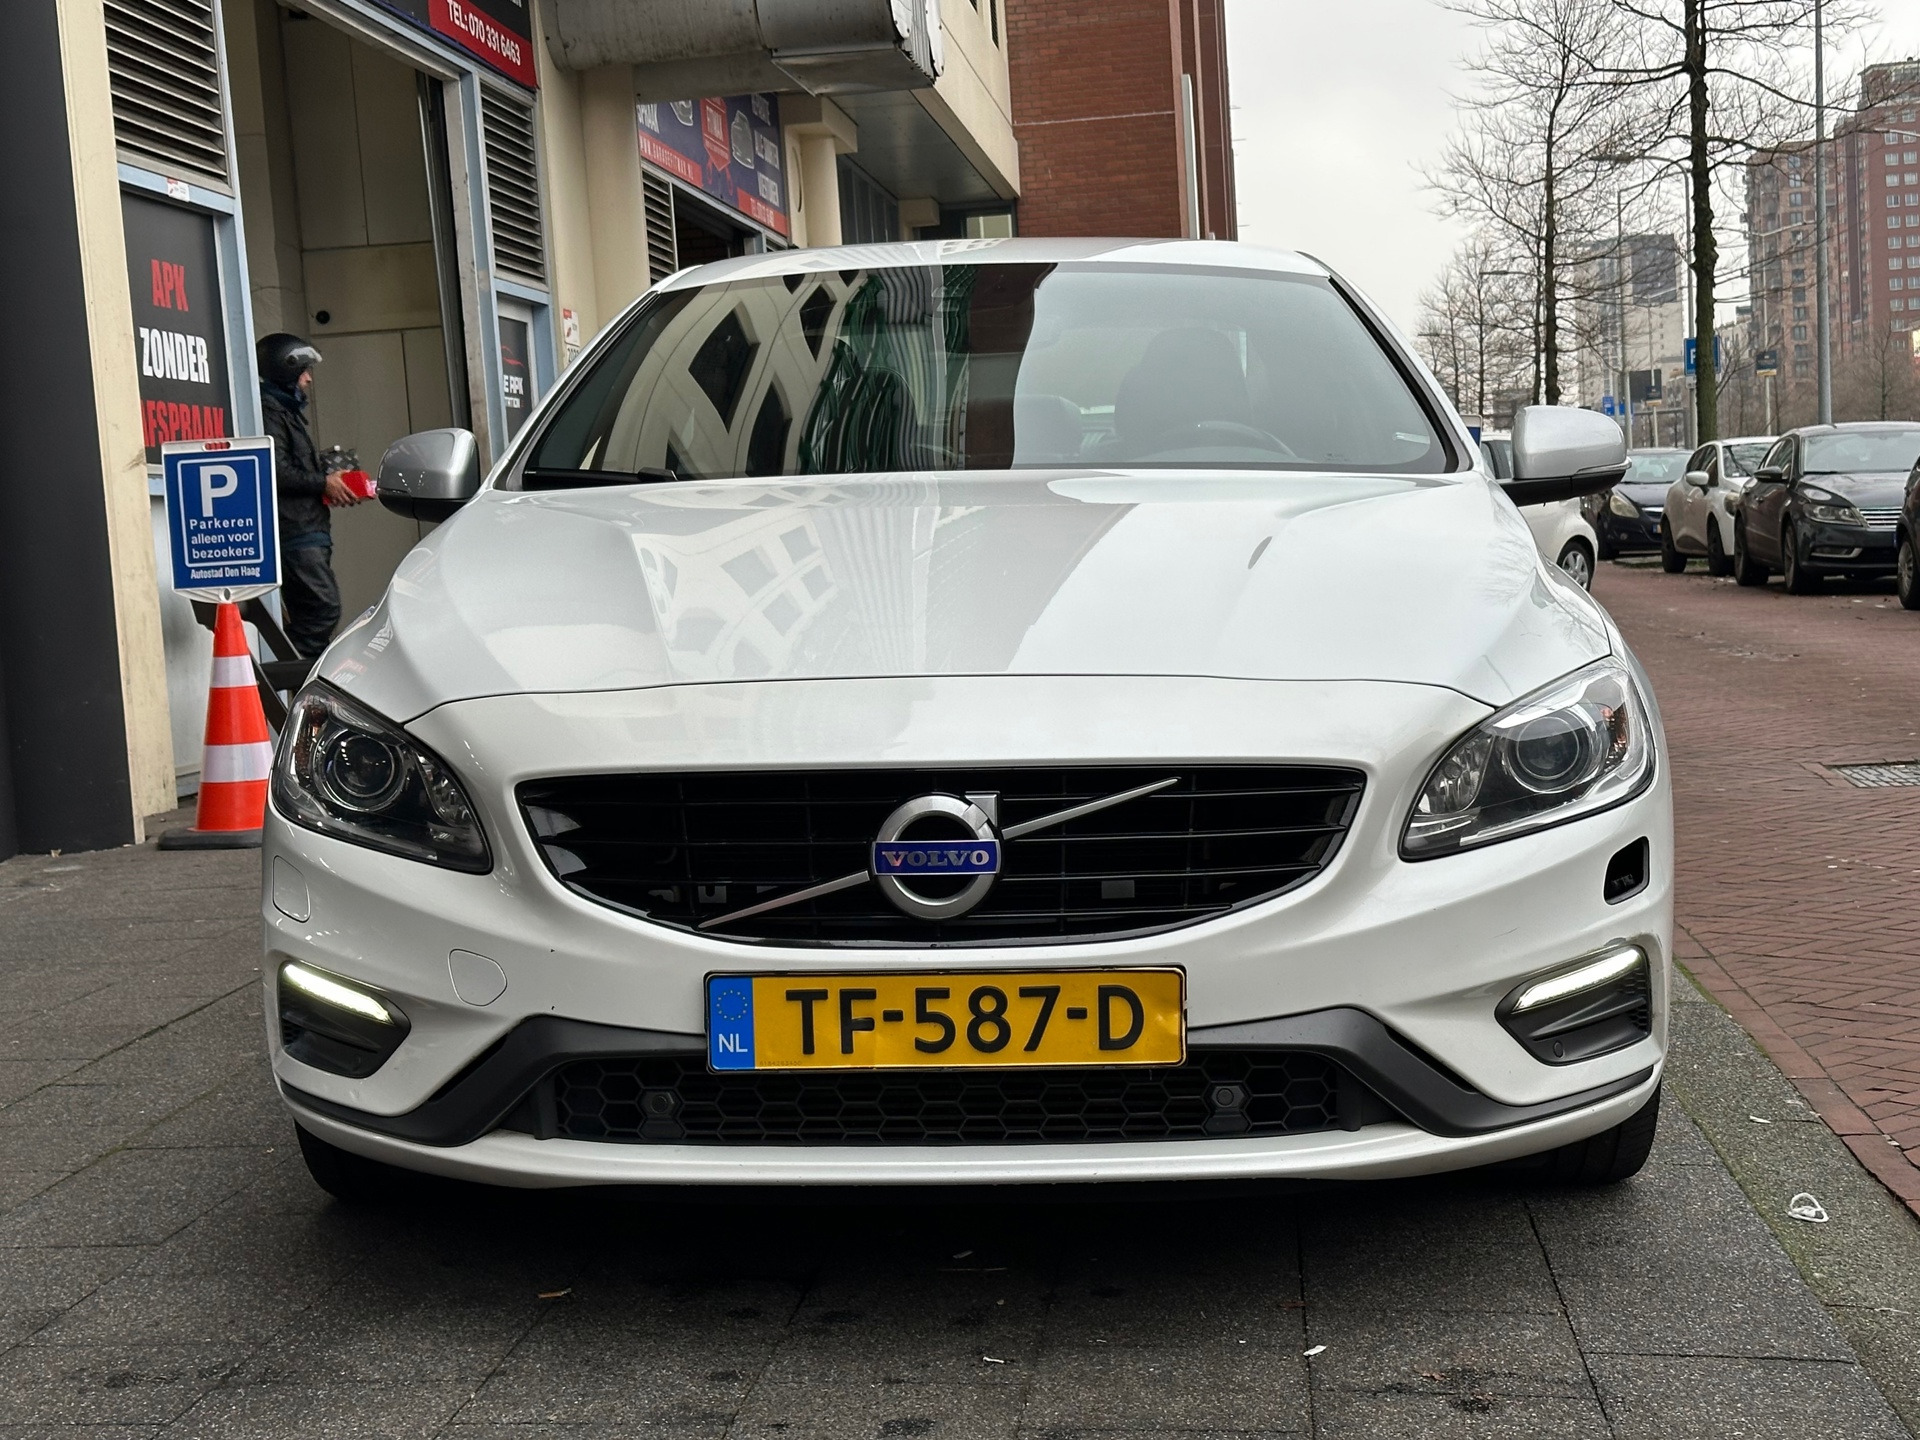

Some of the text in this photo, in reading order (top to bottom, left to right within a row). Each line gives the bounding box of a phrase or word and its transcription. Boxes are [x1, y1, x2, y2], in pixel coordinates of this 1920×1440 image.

[447, 0, 468, 31] TEL:
[469, 13, 485, 43] 070
[486, 25, 500, 53] 331
[152, 259, 189, 312] APK
[139, 327, 210, 384] ZONDER
[200, 465, 238, 518] P
[190, 517, 253, 530] Parkeren
[191, 531, 254, 545] alleen voor
[192, 546, 255, 559] bezoekers
[191, 566, 261, 579] Autostad Den Haag
[882, 850, 989, 867] VOLVO
[785, 985, 1144, 1055] TF-587-D
[718, 1033, 748, 1052] NL
